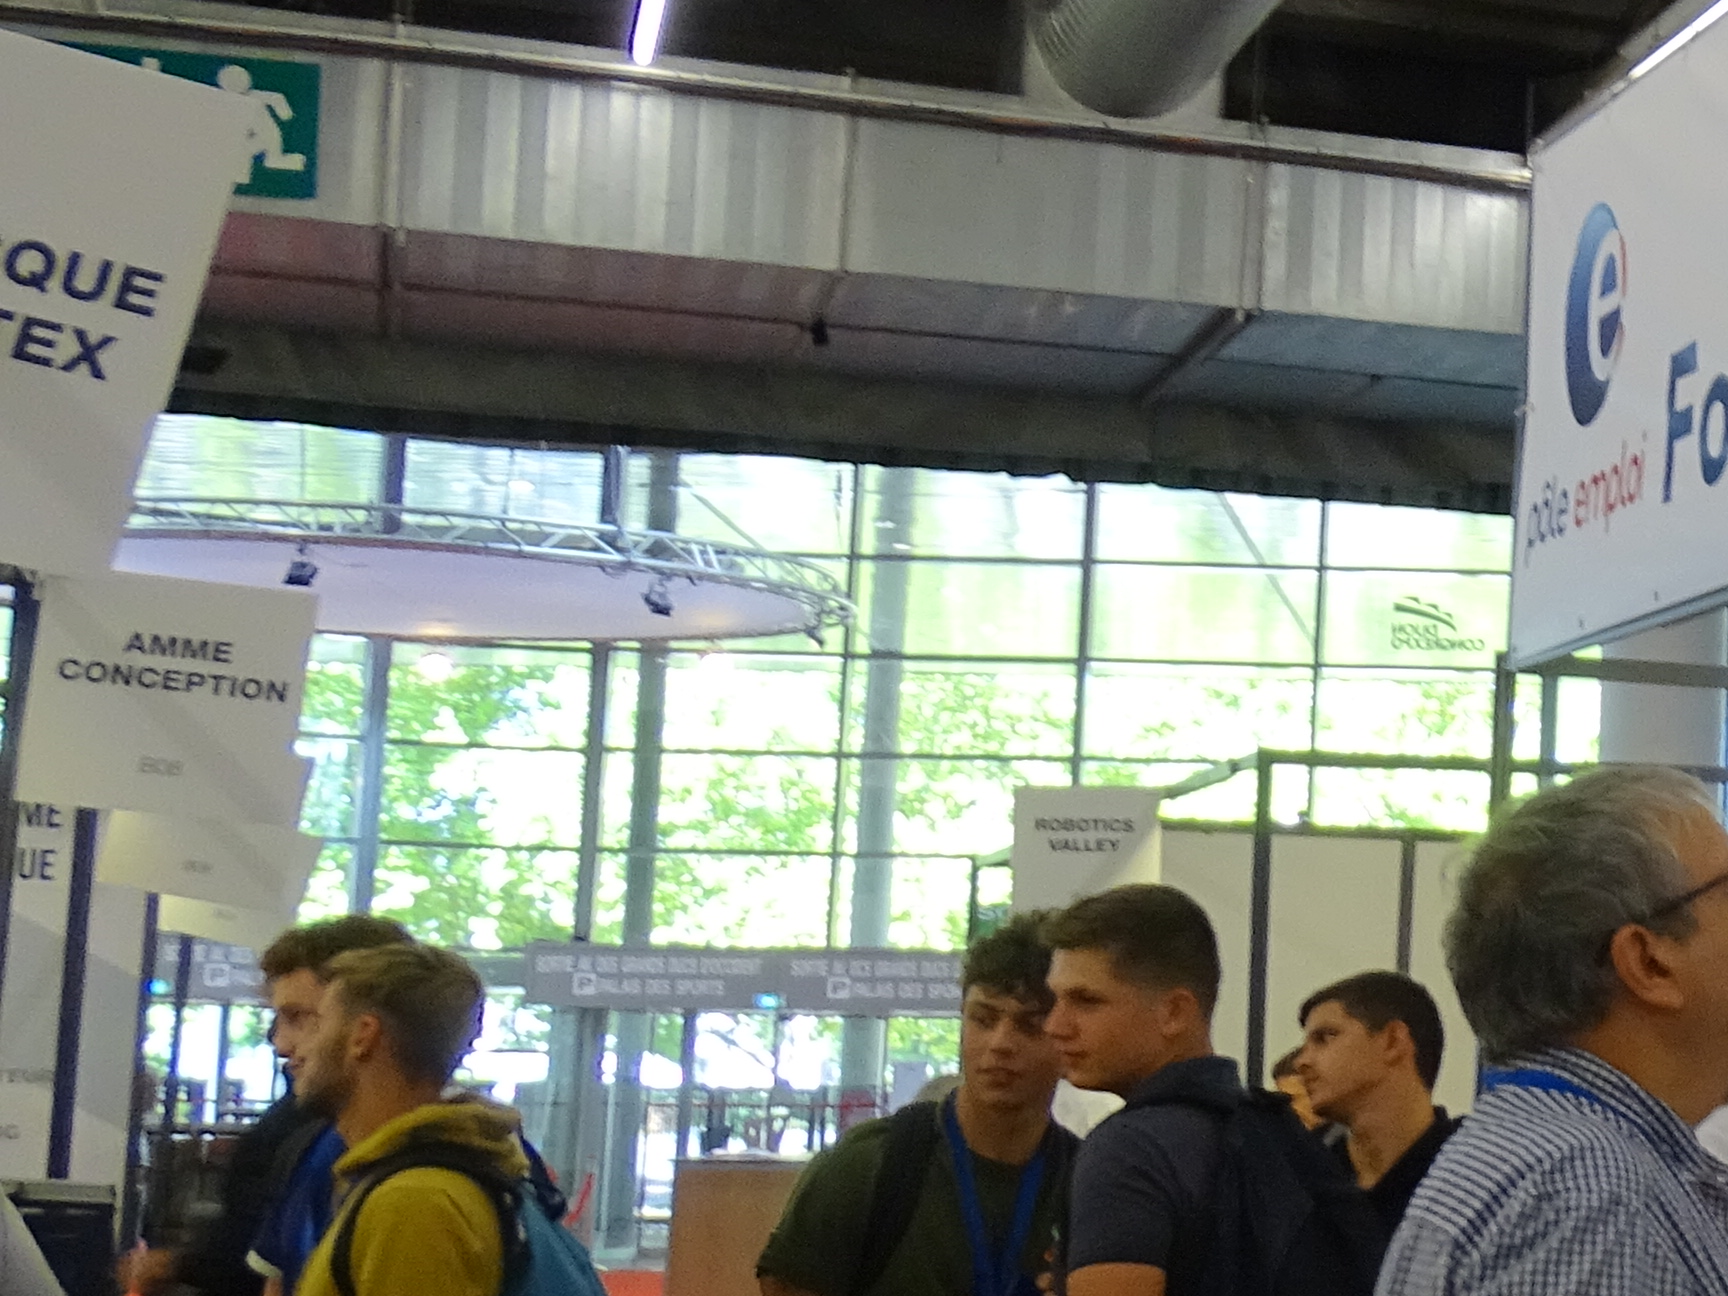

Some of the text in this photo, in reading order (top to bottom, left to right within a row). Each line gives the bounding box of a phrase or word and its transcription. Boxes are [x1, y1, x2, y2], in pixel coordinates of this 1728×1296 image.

[0, 308, 119, 381] EX
[1573, 430, 1648, 534] emploi
[58, 658, 290, 704] CONCEPTION
